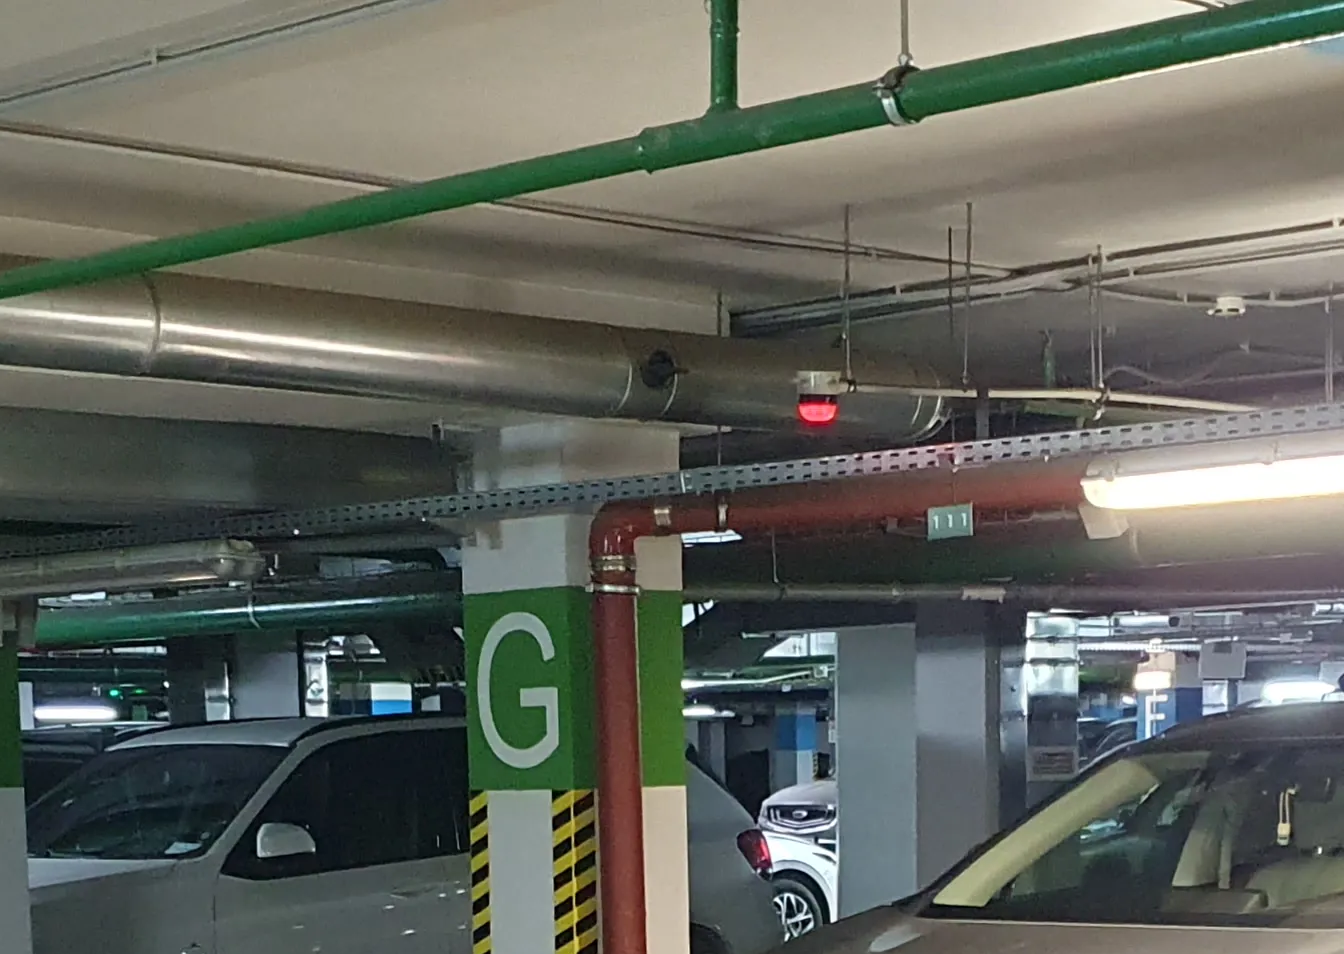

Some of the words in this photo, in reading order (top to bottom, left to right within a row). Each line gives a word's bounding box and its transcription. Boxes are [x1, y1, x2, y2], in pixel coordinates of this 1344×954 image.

[932, 512, 967, 529] 111
[477, 611, 560, 769] G
[1144, 694, 1168, 740] F
